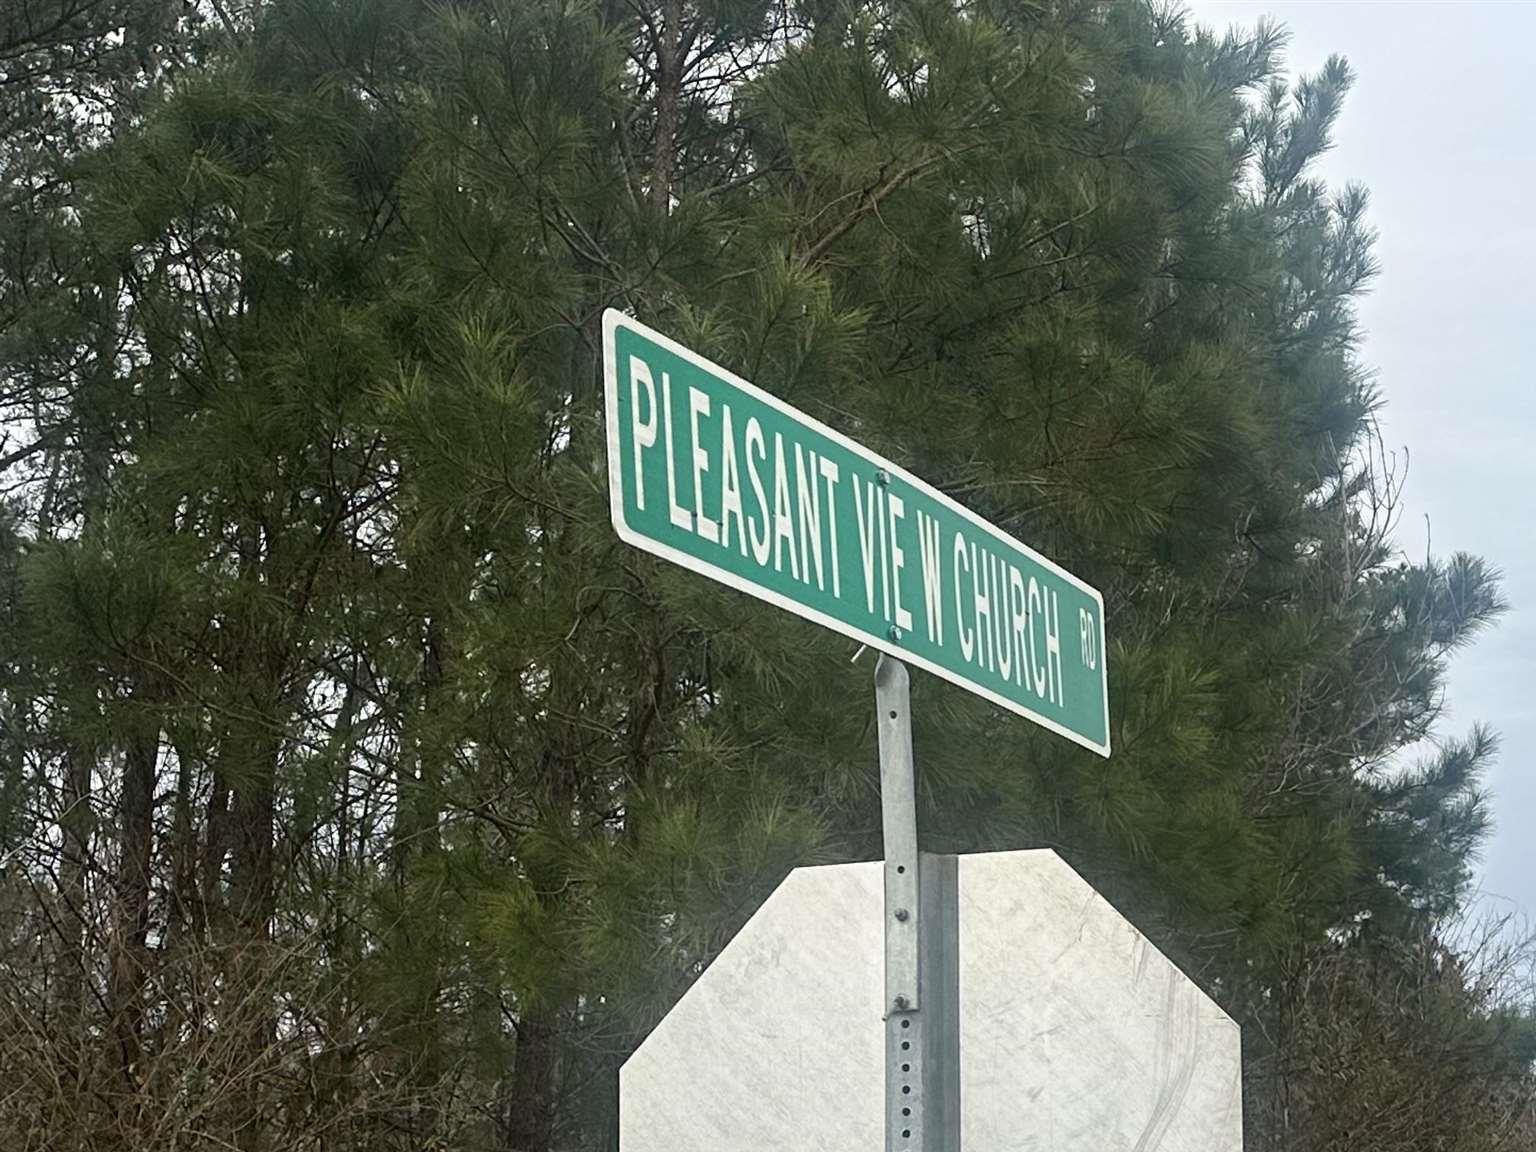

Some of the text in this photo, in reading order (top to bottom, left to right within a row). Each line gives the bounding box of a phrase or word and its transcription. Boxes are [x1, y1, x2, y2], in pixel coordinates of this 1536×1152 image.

[628, 354, 841, 600] PLEASANT
[952, 531, 1065, 709] CHURCH
[1079, 607, 1096, 671] RD
